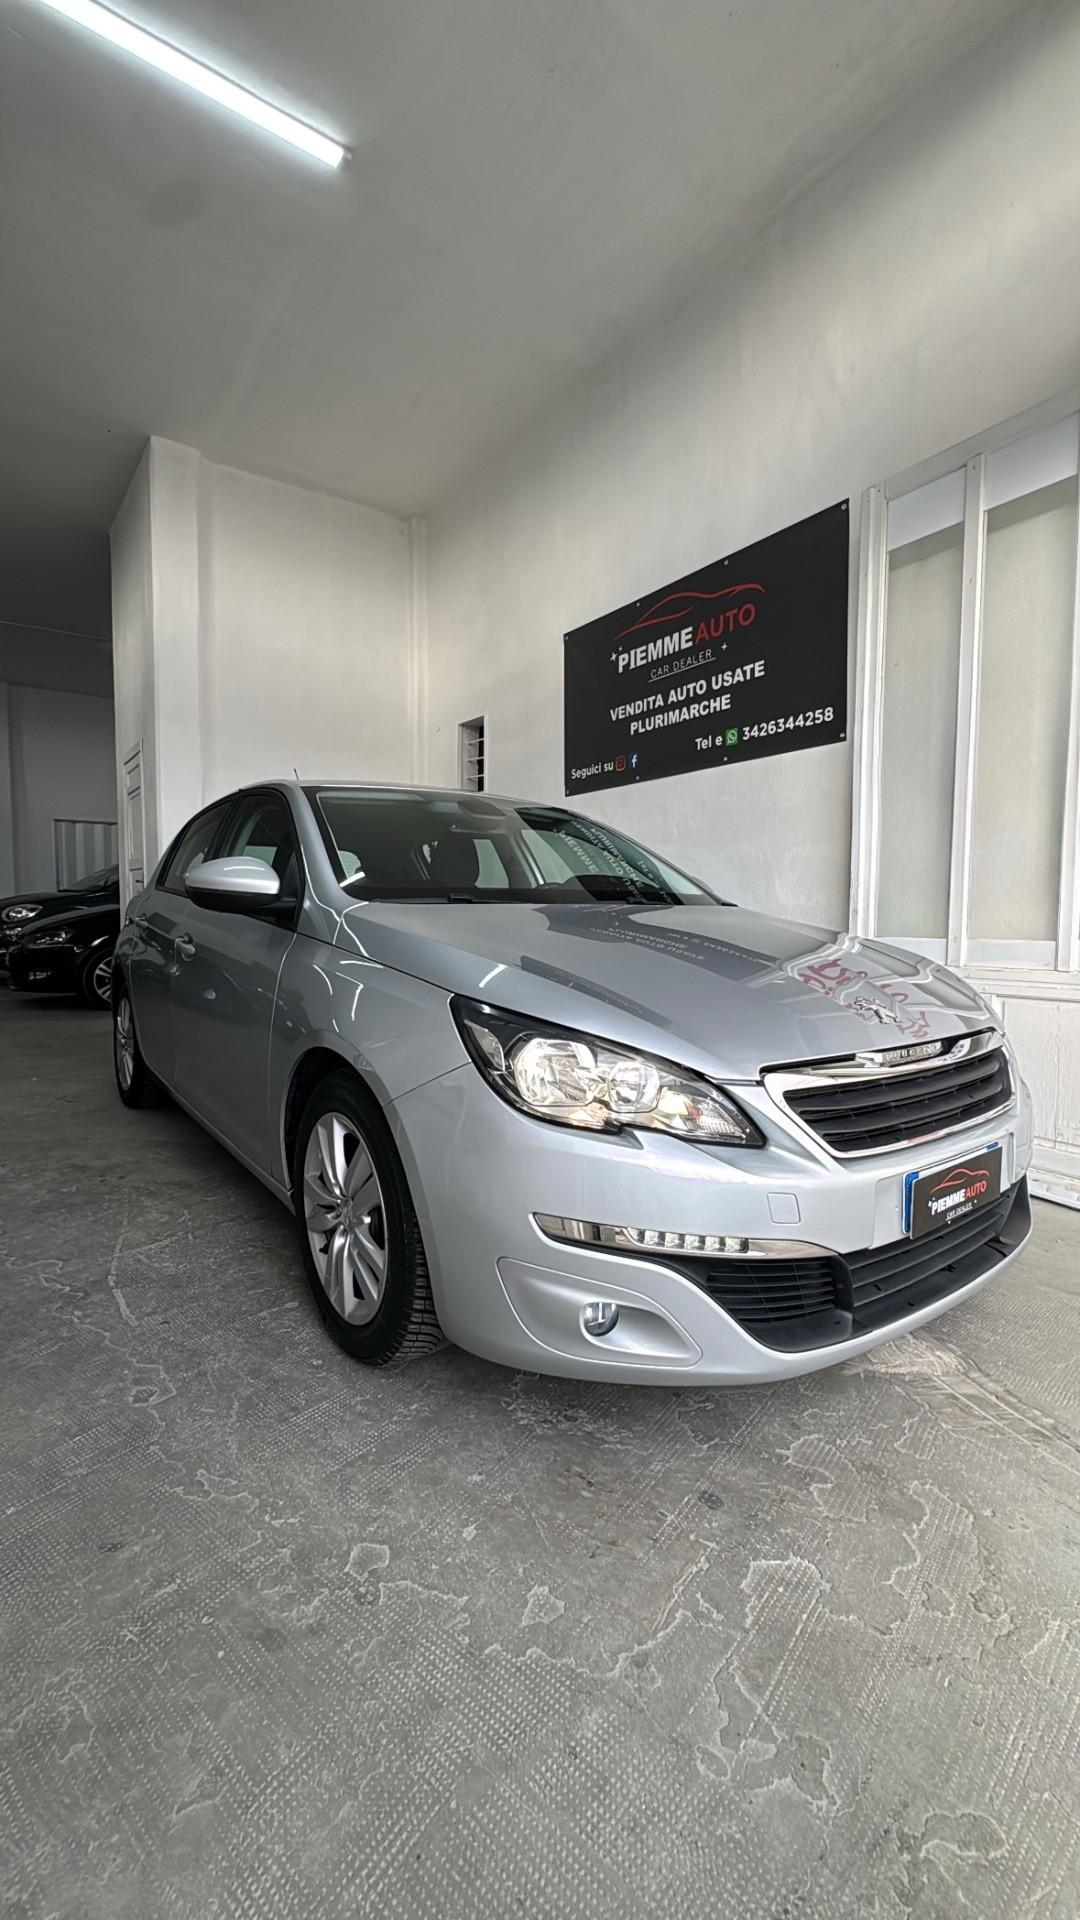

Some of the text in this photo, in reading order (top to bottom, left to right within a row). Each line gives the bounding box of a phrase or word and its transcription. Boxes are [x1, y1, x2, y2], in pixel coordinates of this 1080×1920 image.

[650, 649, 713, 680] CAR DEALER
[609, 660, 765, 722] VENDITA AUTO USATE
[630, 694, 731, 735] PLURIMARCHE
[695, 706, 834, 750] Tel e 3426344258
[571, 761, 614, 780] Seguici su
